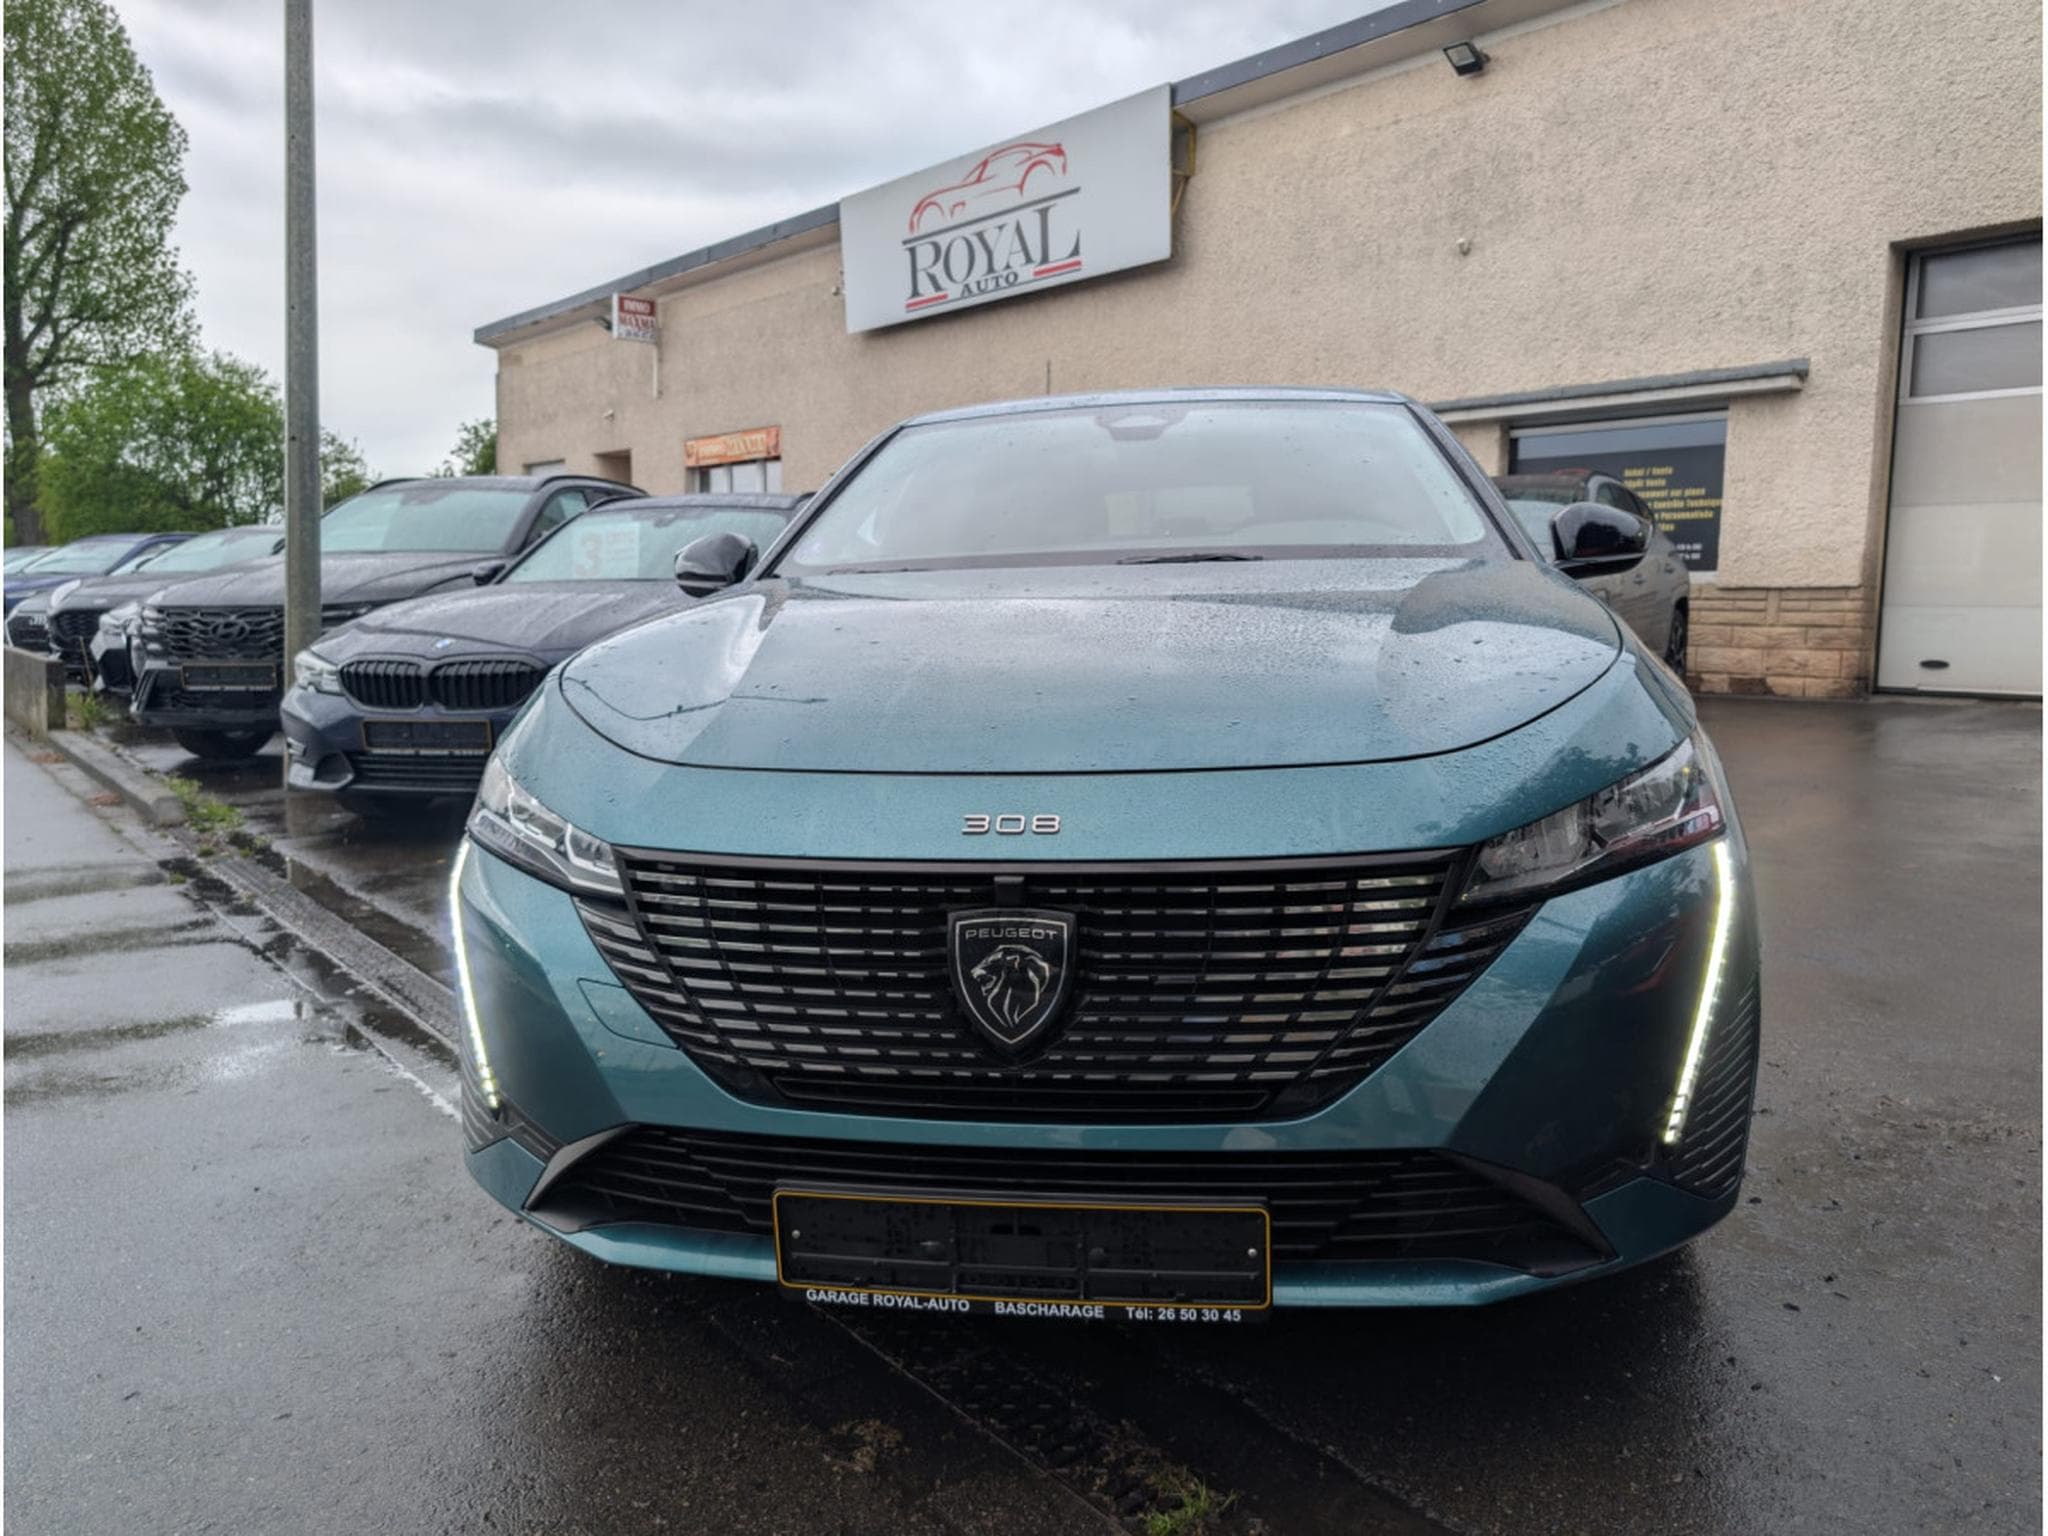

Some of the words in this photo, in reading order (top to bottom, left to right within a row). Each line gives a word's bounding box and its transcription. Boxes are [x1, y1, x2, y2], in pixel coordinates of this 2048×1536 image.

[904, 203, 1081, 298] ROYAL
[960, 271, 1019, 298] AUTO
[962, 814, 1061, 833] 308
[966, 927, 1059, 940] PEUGEOT
[806, 1289, 869, 1306] GARAGE
[873, 1293, 970, 1312] ROYAL-AUTO
[994, 1301, 1105, 1319] BASCHARAGE
[1125, 1306, 1153, 1320] Tél:
[1158, 1307, 1175, 1320] 26
[1180, 1308, 1197, 1321] 50
[1201, 1308, 1219, 1321] 30
[1223, 1309, 1241, 1321] 45
